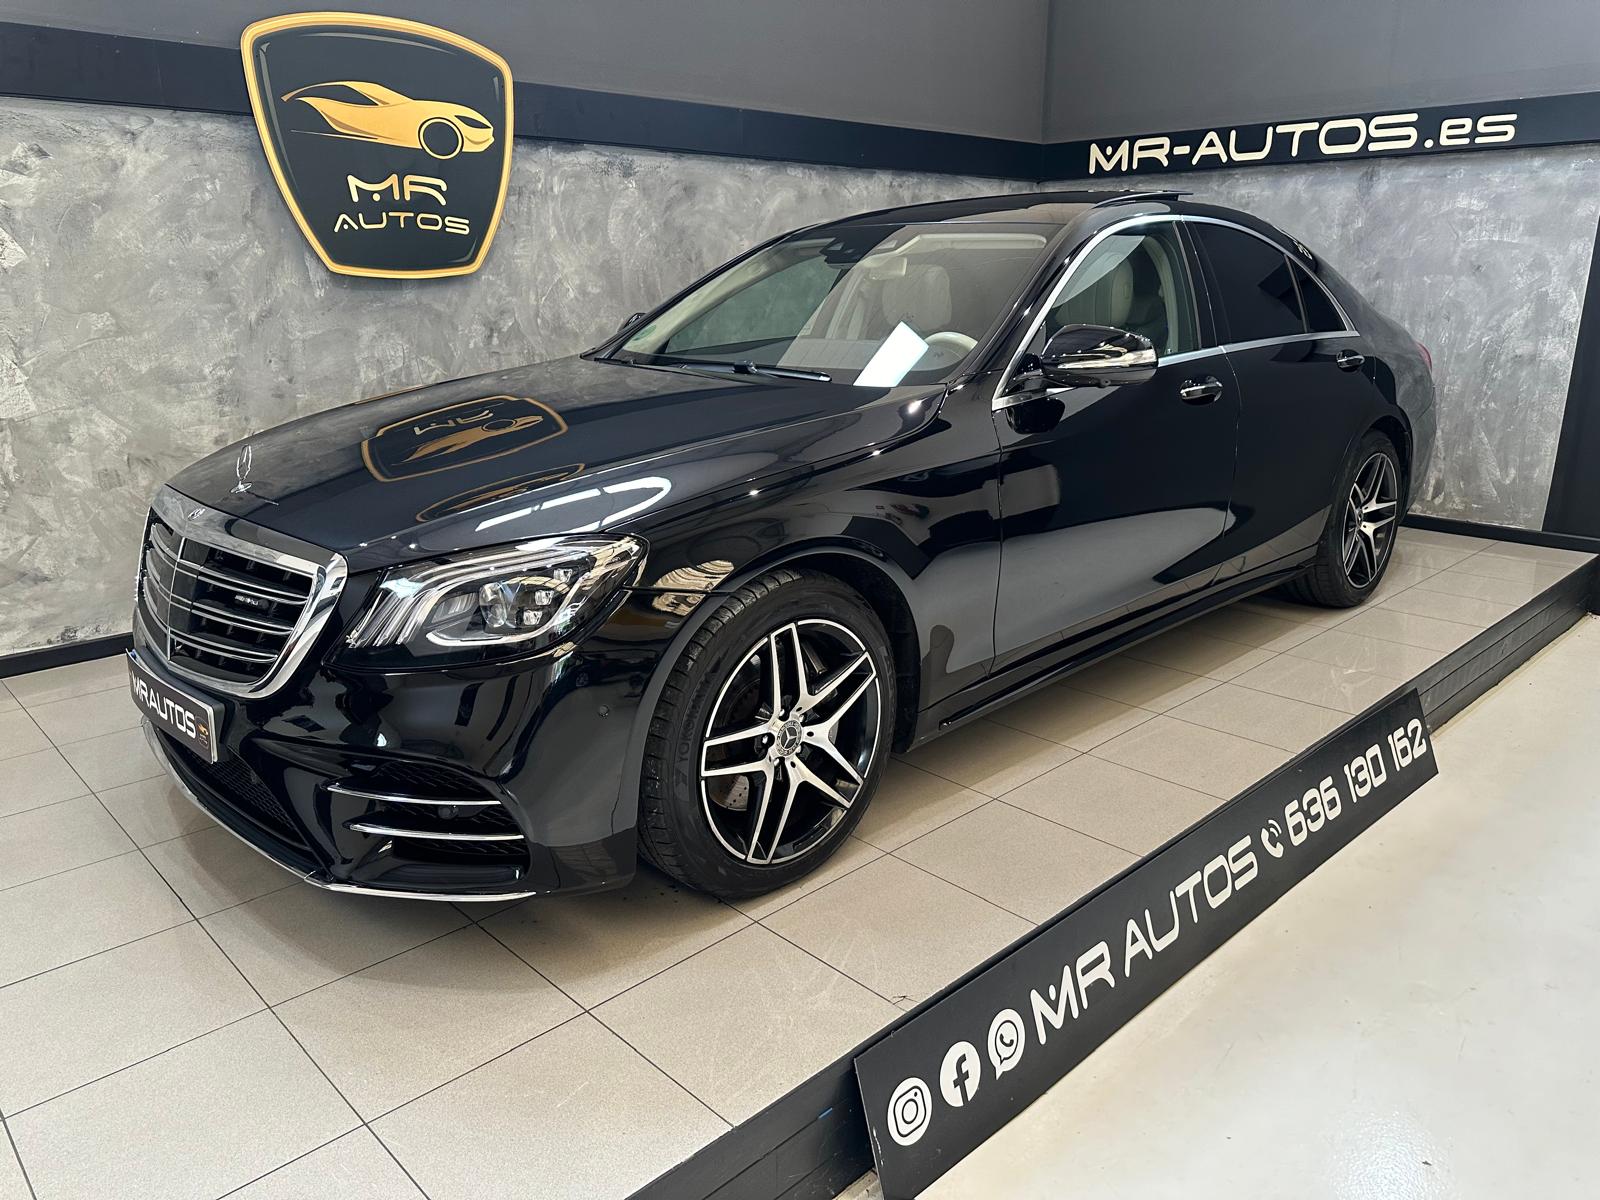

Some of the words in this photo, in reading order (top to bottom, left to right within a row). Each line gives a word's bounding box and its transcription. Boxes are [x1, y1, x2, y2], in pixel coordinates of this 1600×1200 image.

[1089, 113, 1518, 175] MR-AUTOS.es
[347, 174, 448, 206] MR
[333, 211, 470, 235] AUTOS
[1030, 941, 1115, 1045] MR
[1124, 835, 1258, 978] AUTOS
[1284, 775, 1342, 847] 636
[1343, 743, 1387, 803] 130
[1387, 718, 1427, 772] 162
